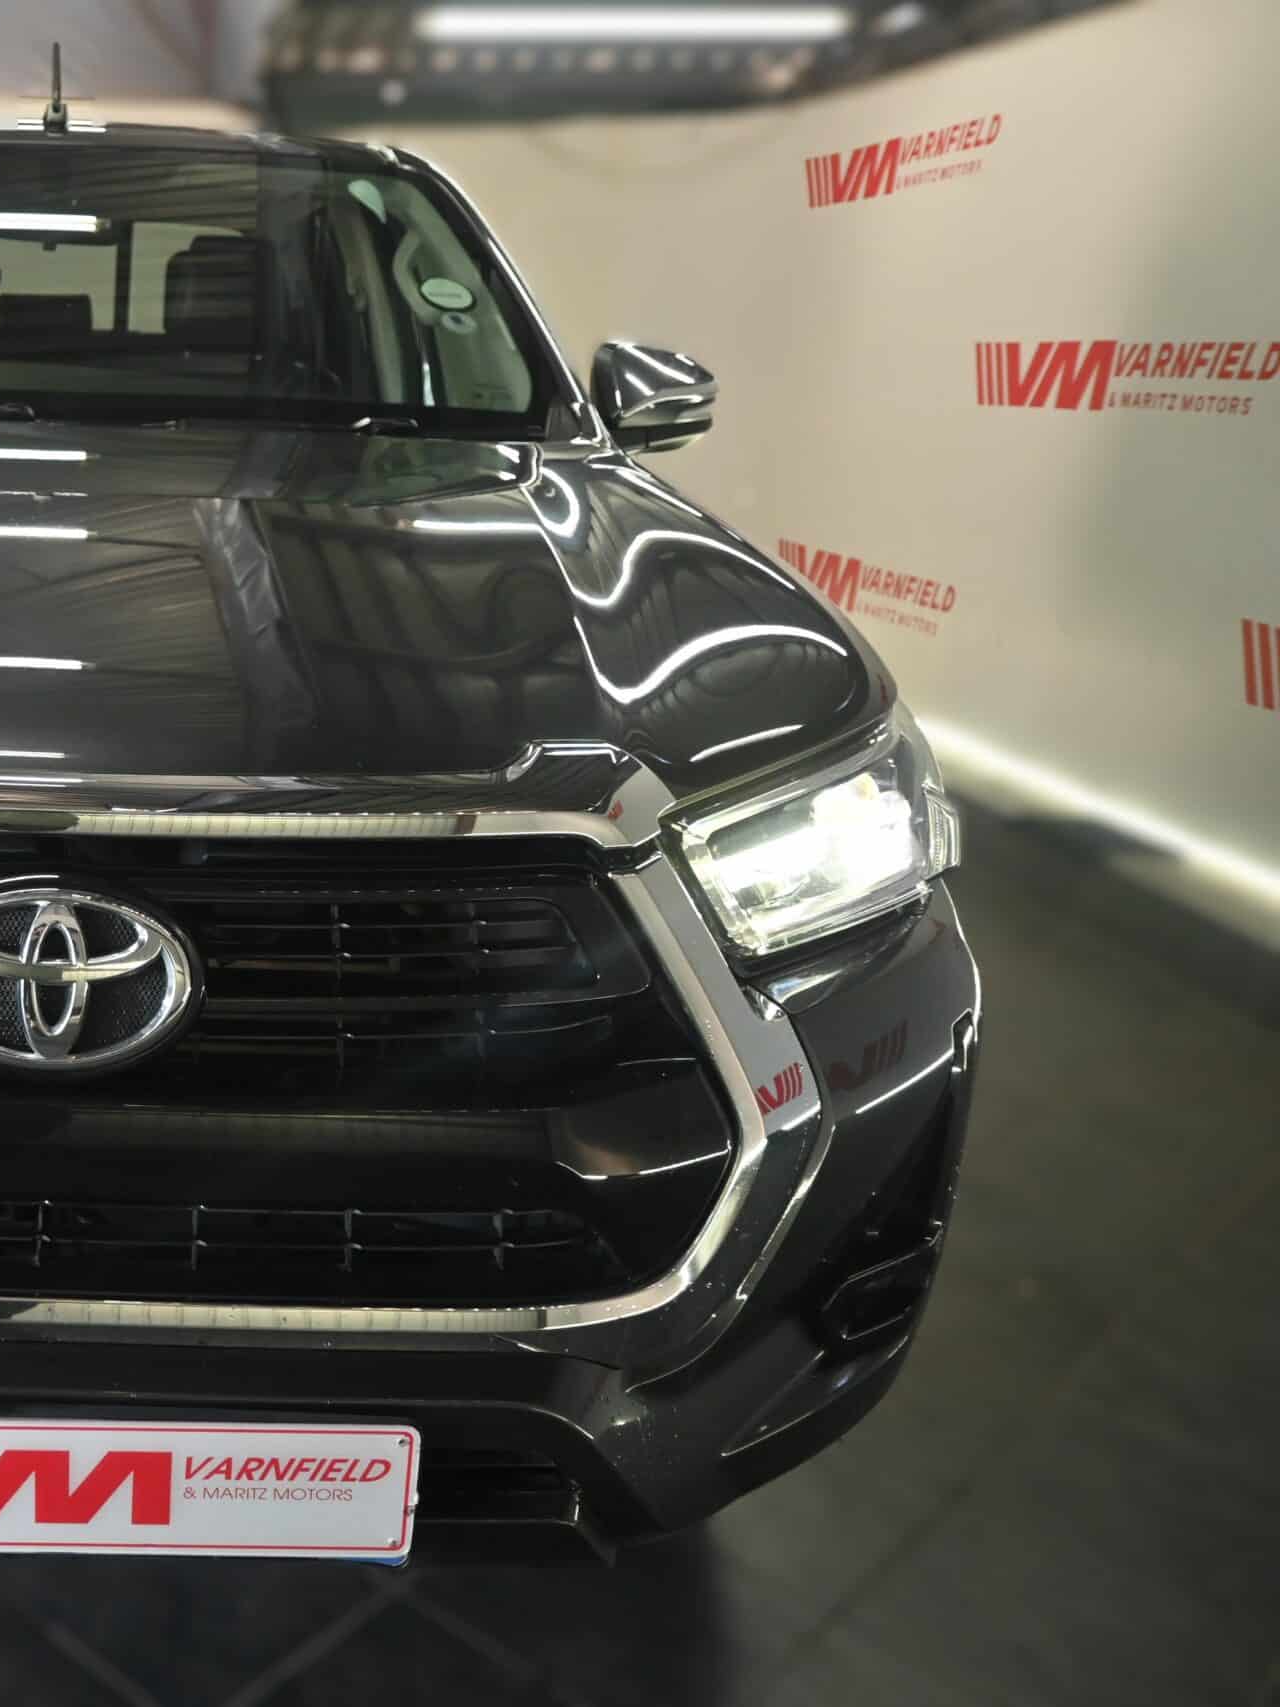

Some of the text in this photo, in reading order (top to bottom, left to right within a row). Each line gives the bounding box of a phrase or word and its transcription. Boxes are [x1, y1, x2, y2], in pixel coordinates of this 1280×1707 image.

[899, 113, 1002, 166] VARNFIELD
[1114, 341, 1280, 380] VARNFIELD
[1120, 391, 1177, 411] MARITZ
[1181, 394, 1254, 416] MOTORS
[862, 564, 958, 612] VARNFIELD
[184, 1456, 392, 1482] VARNFIELD
[183, 1487, 353, 1502] & MARITZ MOTORS
